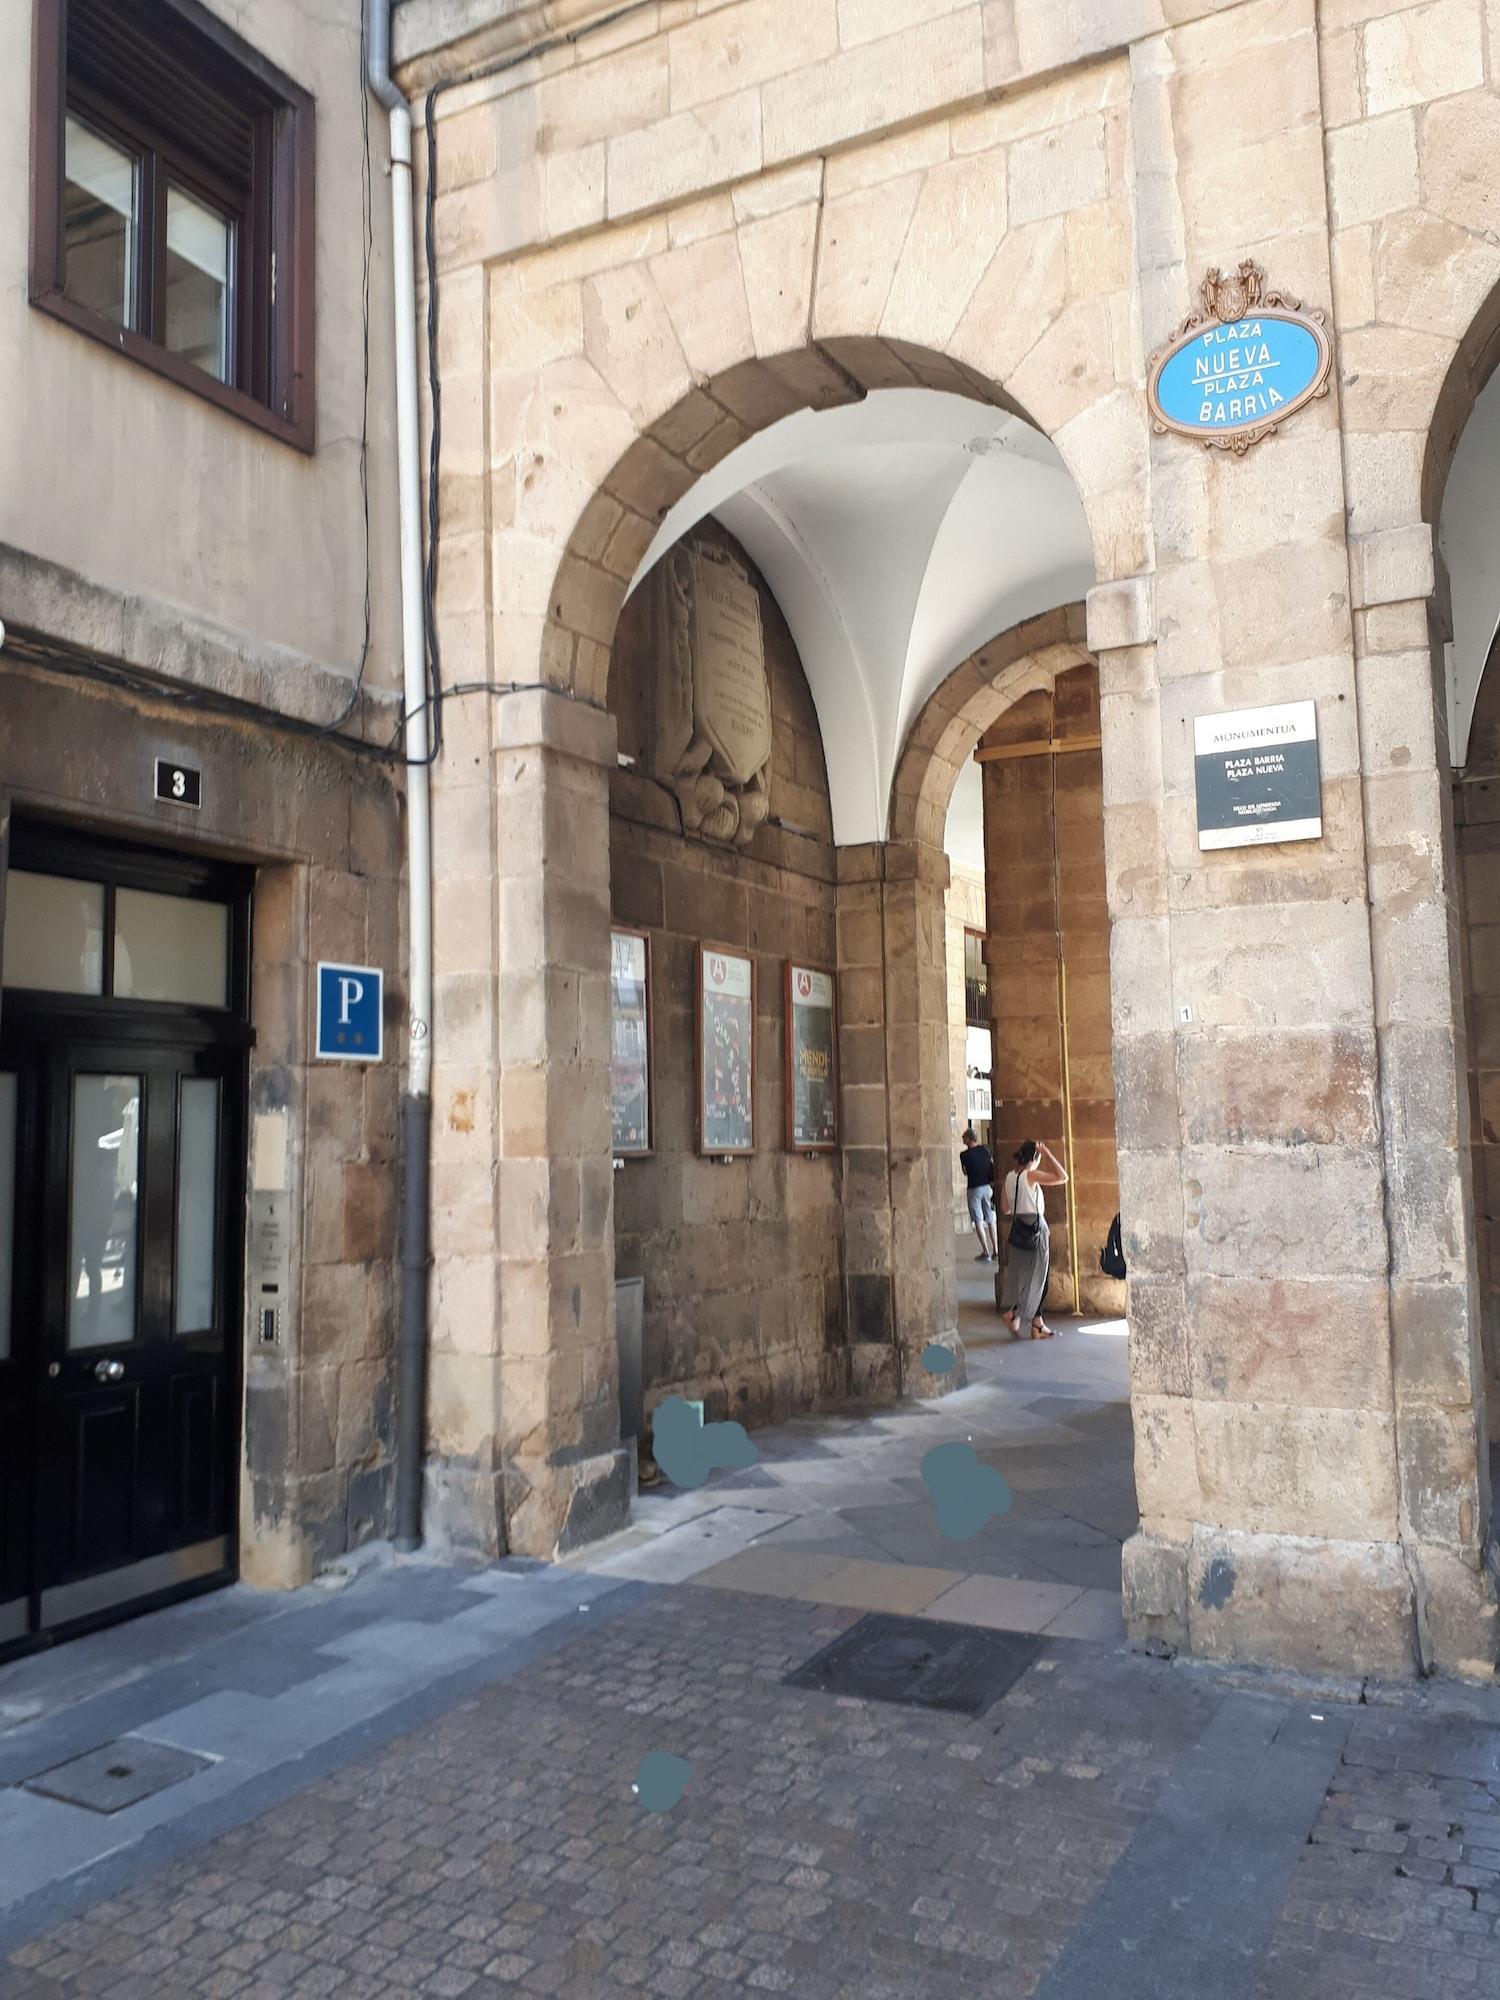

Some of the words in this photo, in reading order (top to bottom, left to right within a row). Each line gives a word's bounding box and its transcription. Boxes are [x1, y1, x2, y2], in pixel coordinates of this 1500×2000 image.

[1203, 322, 1262, 347] PLAZA
[1195, 343, 1271, 378] NUEVA
[1204, 372, 1264, 396] PLAZA
[1199, 387, 1284, 422] BARRIA
[1213, 724, 1296, 742] MONUMENTUA
[1225, 758, 1252, 769] PLAZA
[1254, 754, 1285, 765] BARRIA
[1226, 768, 1253, 778] PLAZA
[1255, 764, 1284, 775] NUEVA
[172, 770, 186, 797] 3
[338, 976, 363, 1024] P
[1182, 1008, 1189, 1020] 1
